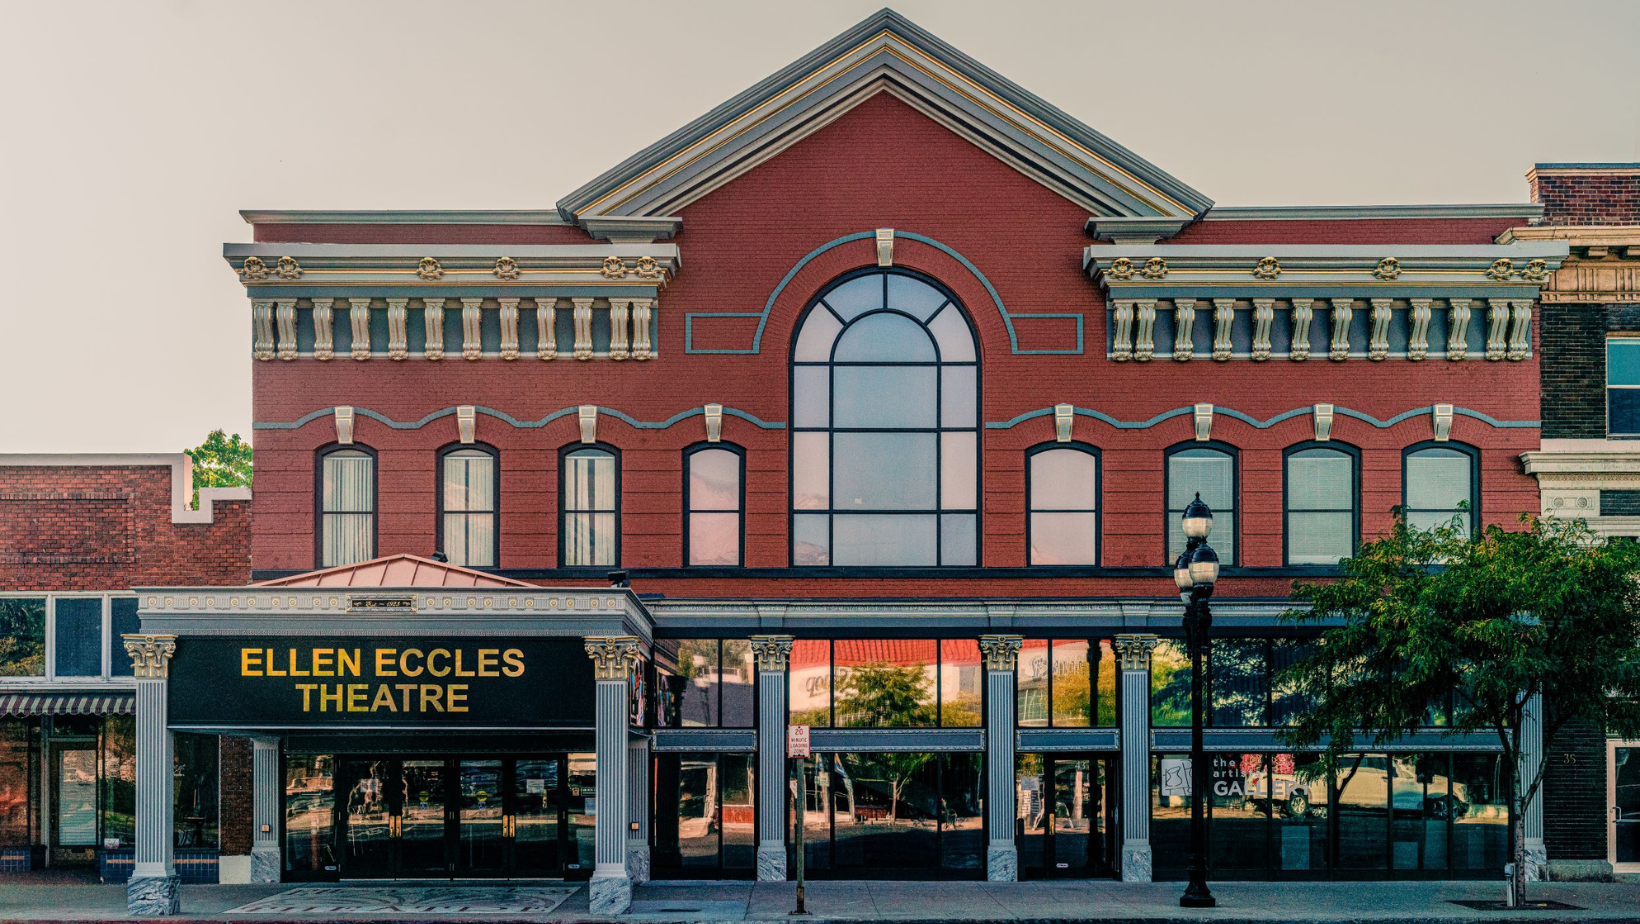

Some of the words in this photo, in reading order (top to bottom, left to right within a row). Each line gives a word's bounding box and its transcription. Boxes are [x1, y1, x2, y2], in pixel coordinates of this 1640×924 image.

[241, 648, 361, 677] ELLEN
[375, 648, 526, 678] ECCLES
[295, 684, 469, 712] THEATRE
[1212, 759, 1236, 767] the
[1563, 753, 1577, 764] 35
[1074, 761, 1086, 770] 43
